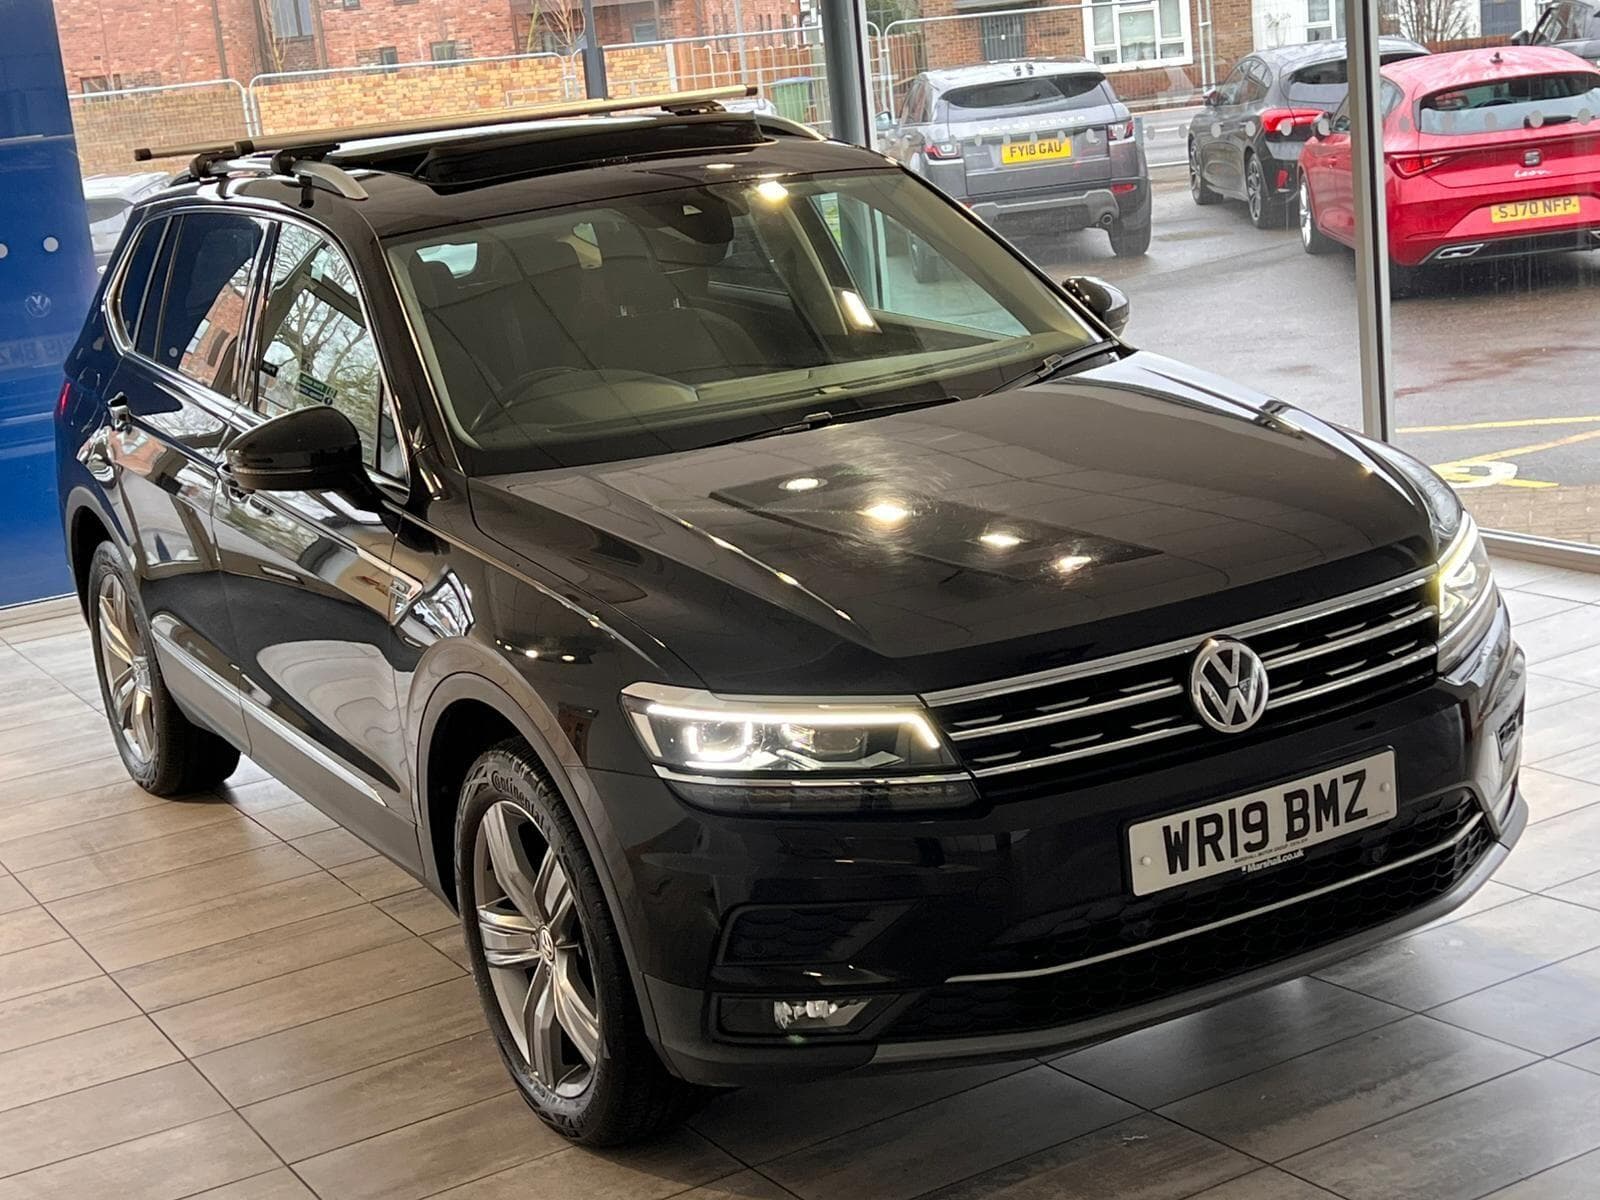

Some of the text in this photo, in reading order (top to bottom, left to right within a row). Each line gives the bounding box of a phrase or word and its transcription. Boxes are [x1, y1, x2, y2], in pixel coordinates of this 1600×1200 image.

[1009, 141, 1062, 158] FY18 GAU
[1498, 198, 1572, 219] SJ70 NFP
[491, 769, 545, 831] Continental
[1162, 768, 1368, 875] WR19 BMZ
